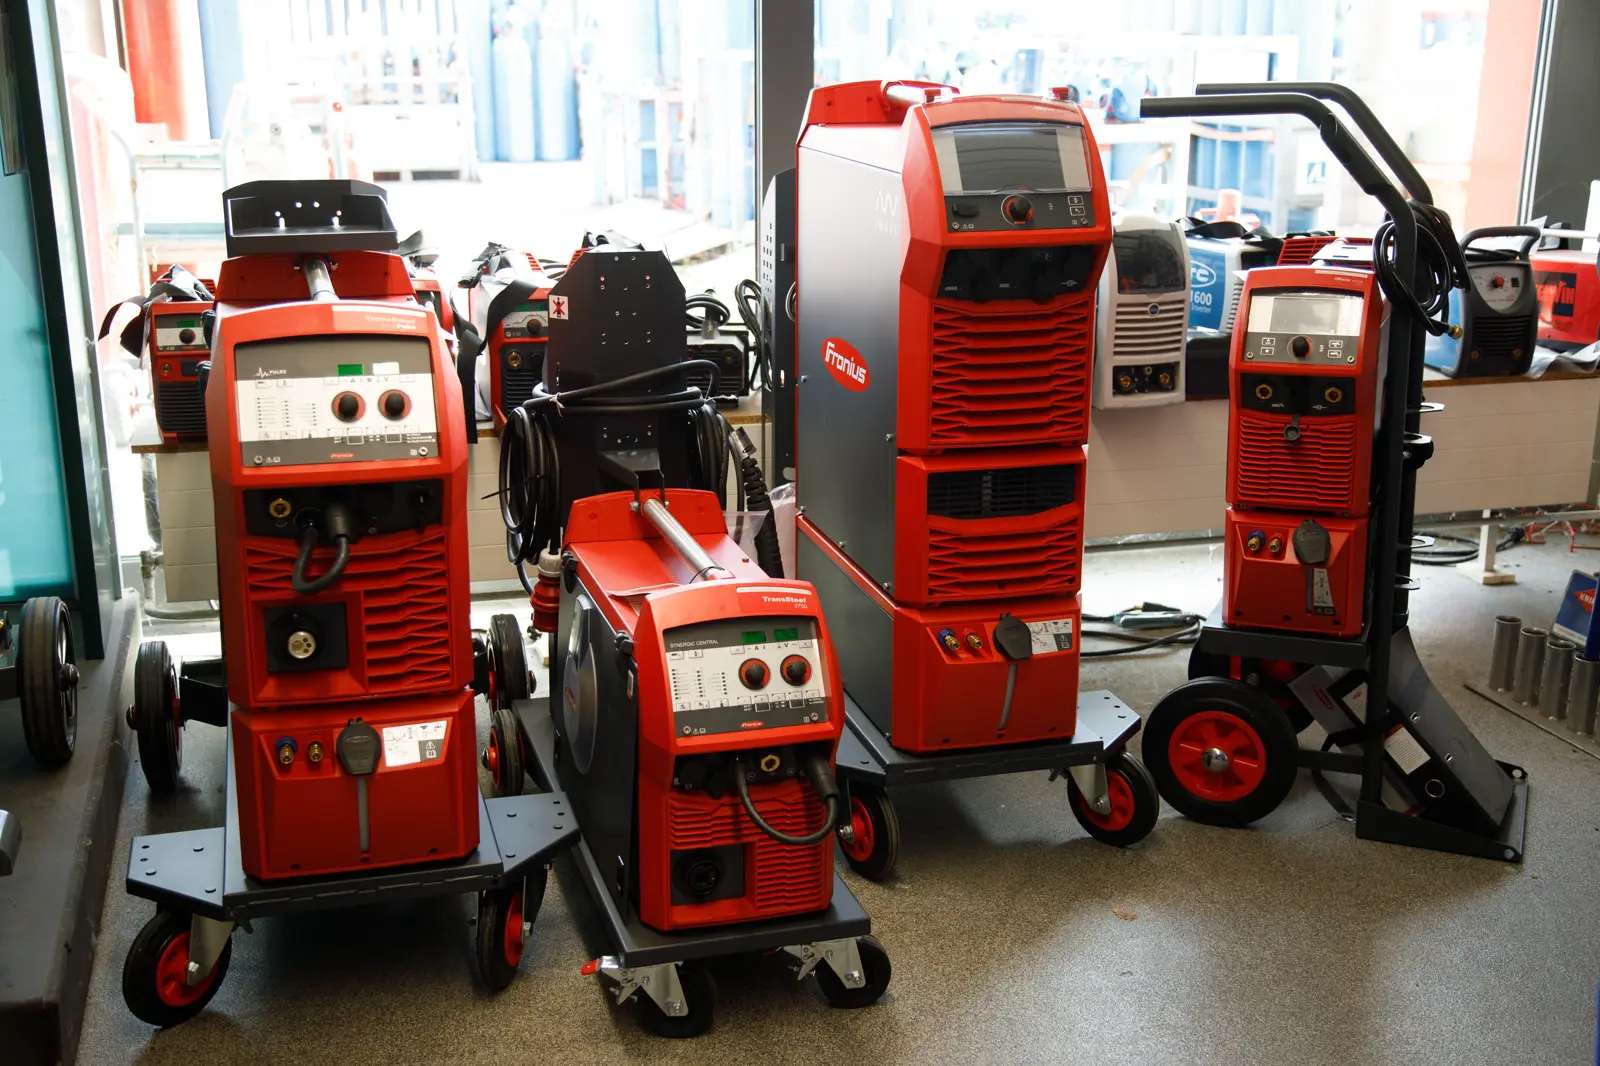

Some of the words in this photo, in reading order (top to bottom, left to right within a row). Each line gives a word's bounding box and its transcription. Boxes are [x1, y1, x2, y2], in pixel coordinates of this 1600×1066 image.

[1191, 267, 1209, 282] rc
[825, 341, 867, 384] Fronius
[762, 596, 807, 604] TransSteel
[669, 641, 695, 649] SYNERGIC
